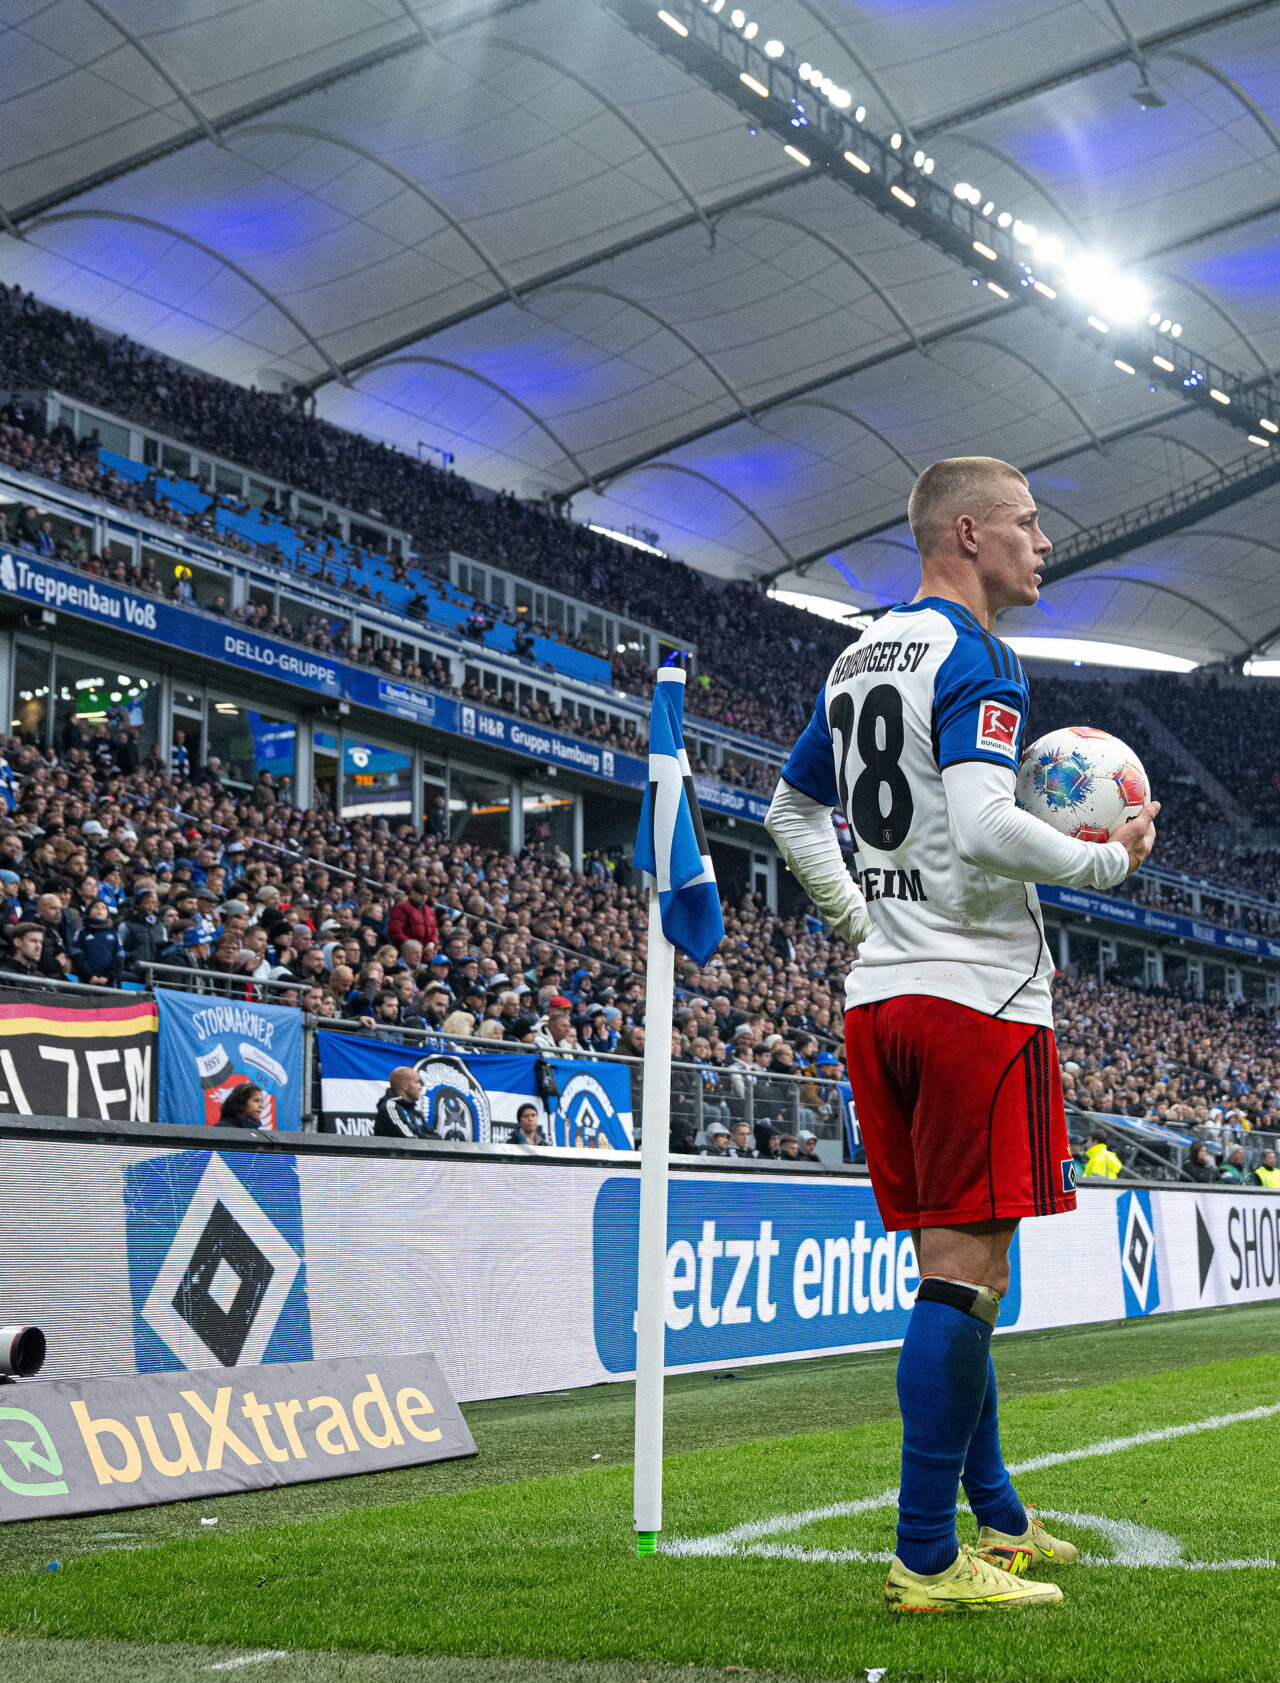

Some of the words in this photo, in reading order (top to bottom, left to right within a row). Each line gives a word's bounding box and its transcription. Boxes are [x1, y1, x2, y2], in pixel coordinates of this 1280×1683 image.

[16, 561, 121, 619] Treppenbau
[123, 597, 157, 630] Voß
[224, 635, 336, 685] DELLO-GRUPPE
[831, 641, 903, 687] HAMBURGER
[897, 641, 930, 673] SV
[478, 715, 505, 739] H&R
[510, 726, 551, 754] Gruppe
[552, 738, 600, 772] Hamburg
[980, 739, 1014, 755] BUNDESLIGA
[193, 1006, 275, 1051] STORMARNER
[633, 1221, 780, 1334] etzt
[70, 1373, 443, 1485] buXtrade
